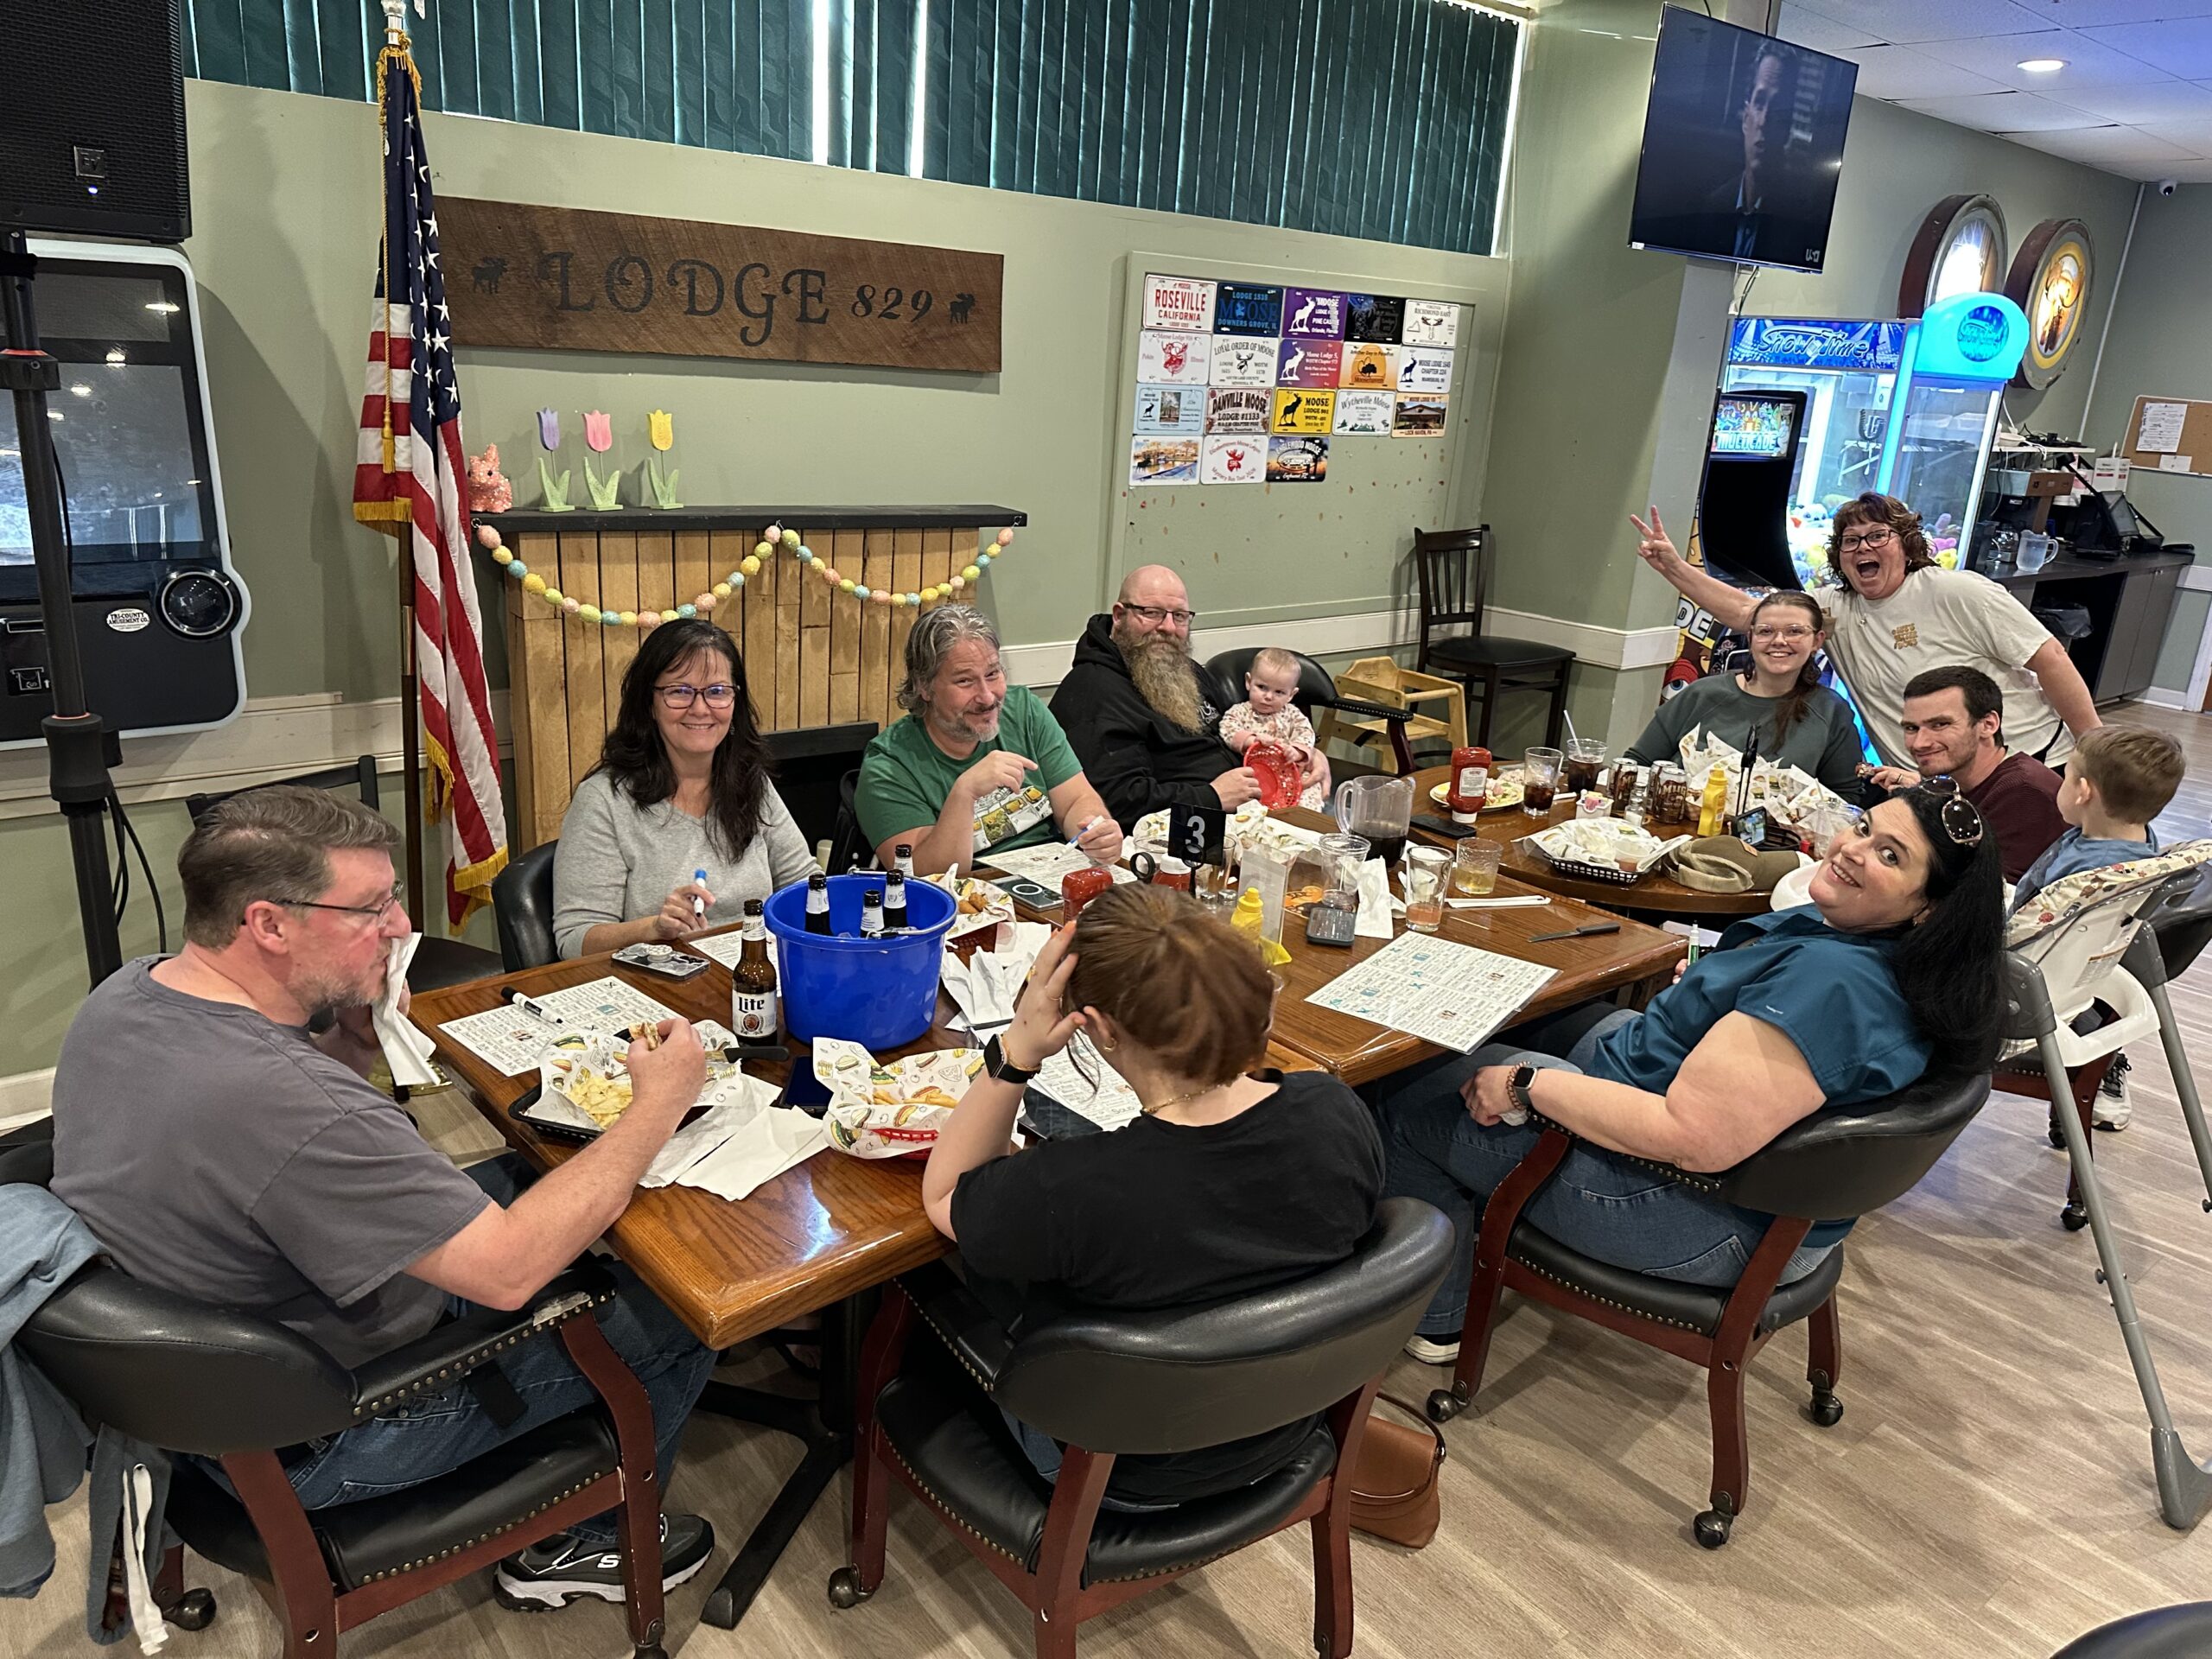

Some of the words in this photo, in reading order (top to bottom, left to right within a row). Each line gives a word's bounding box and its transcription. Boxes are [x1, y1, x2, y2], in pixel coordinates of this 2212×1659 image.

[536, 251, 830, 347] LODGE
[850, 283, 933, 323] 829
[1154, 289, 1206, 312] ROSEVILLE
[1232, 291, 1253, 300] LODGE
[1158, 309, 1201, 321] CALIFORNIA
[1414, 308, 1440, 316] RICHMOND
[1217, 318, 1248, 327] DOWNERS
[1214, 342, 1230, 355] LOYAL
[1230, 341, 1249, 351] ORDER
[1249, 342, 1257, 351] OF
[1257, 343, 1275, 357] MOOSE
[1758, 325, 1812, 354] Show
[1817, 329, 1869, 359] Time
[1212, 391, 1243, 415] DANVILLE
[1244, 392, 1267, 414] MOOSE
[1305, 397, 1329, 406] MOOSE
[1217, 412, 1240, 421] LODGE
[1241, 412, 1260, 421] #1133
[1716, 432, 1777, 450] MULTICADE
[1662, 785, 1687, 796] MUG
[1185, 815, 1205, 855] 3
[738, 996, 765, 1014] Lite
